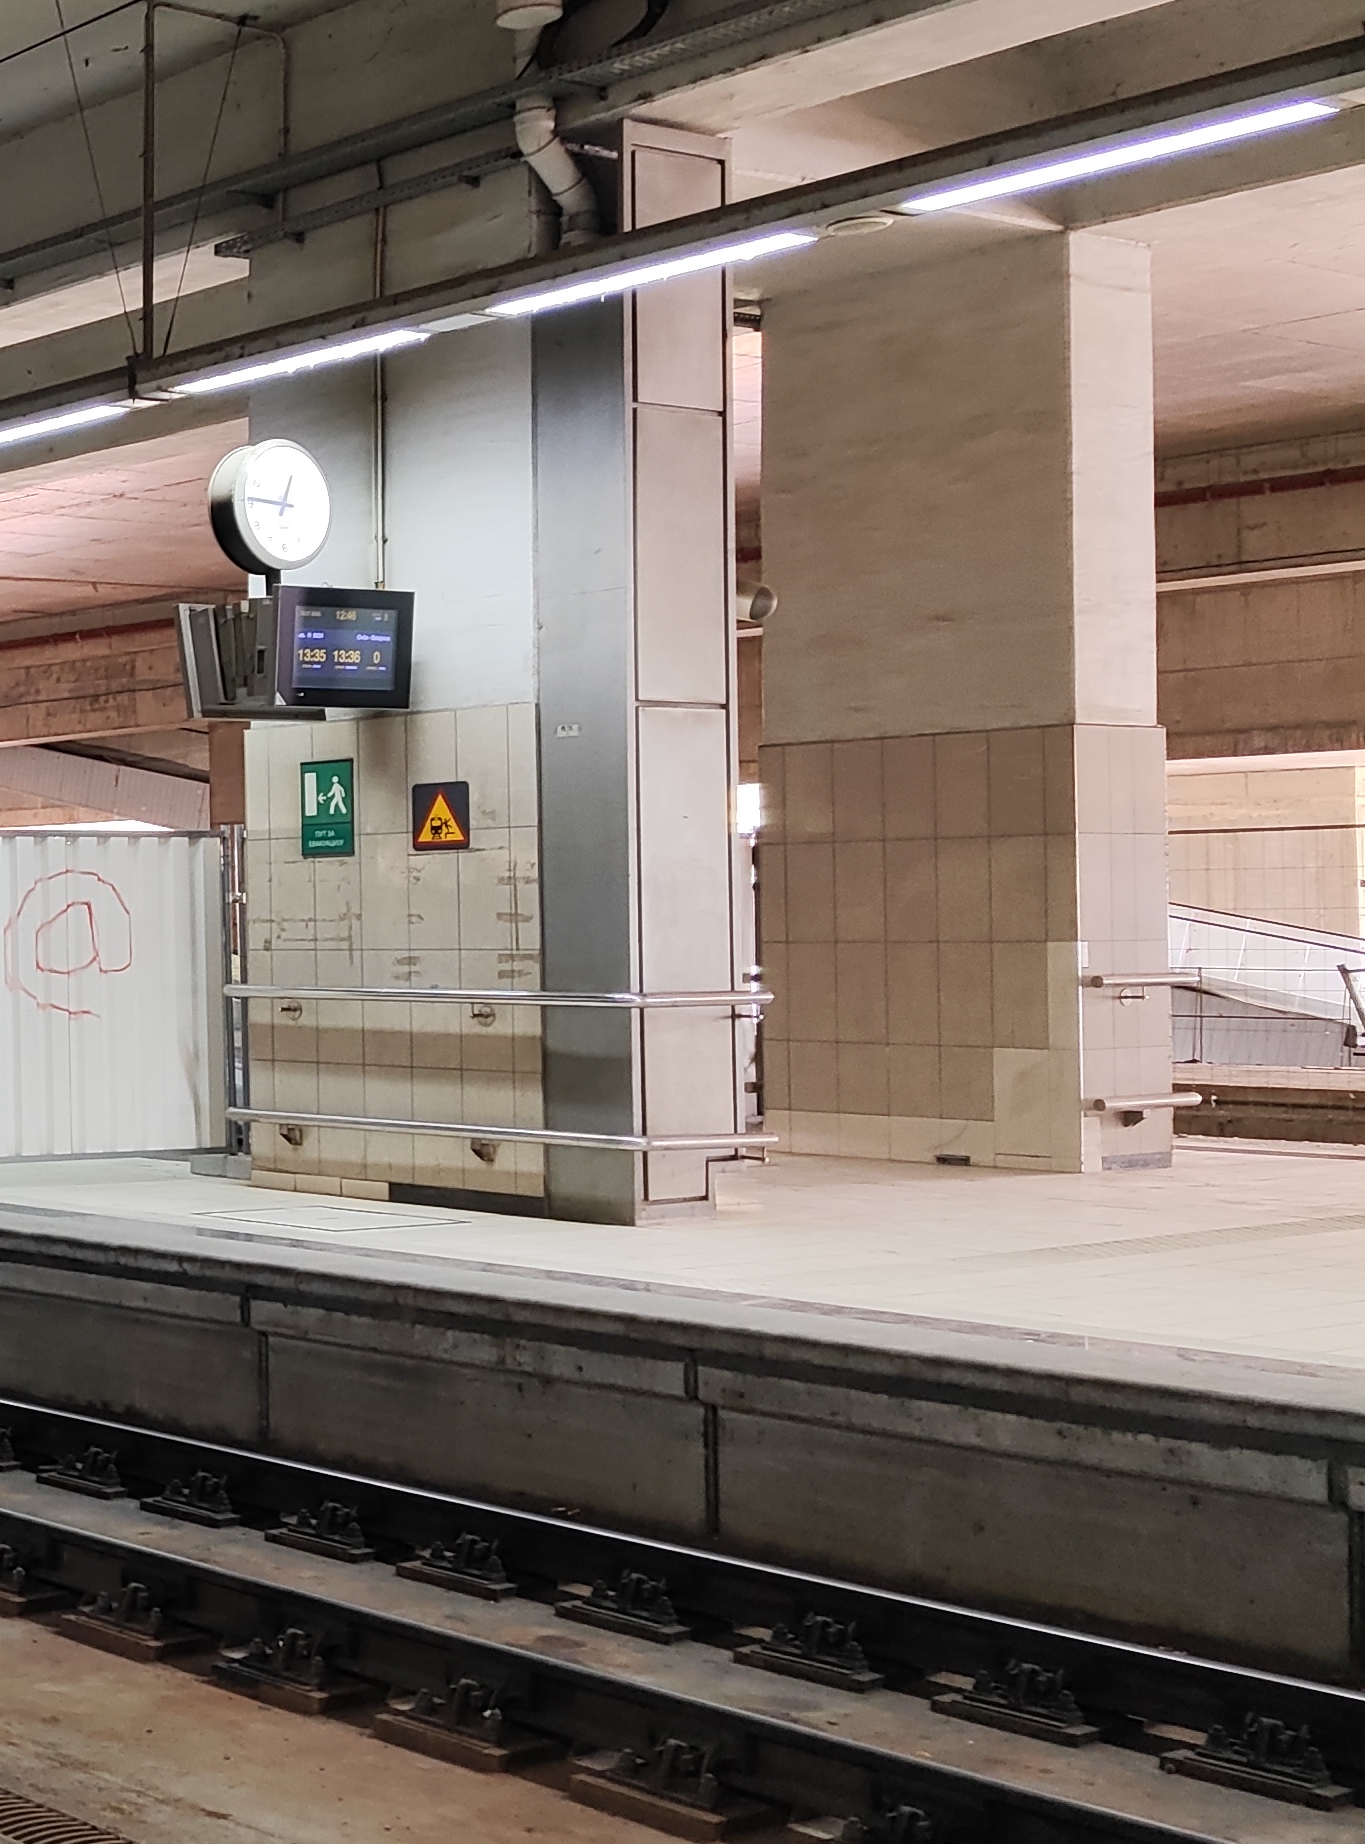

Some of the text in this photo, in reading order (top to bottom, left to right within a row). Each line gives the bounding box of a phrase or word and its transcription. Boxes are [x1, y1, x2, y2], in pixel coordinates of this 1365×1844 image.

[298, 649, 381, 663] 13:35 13:36 0
